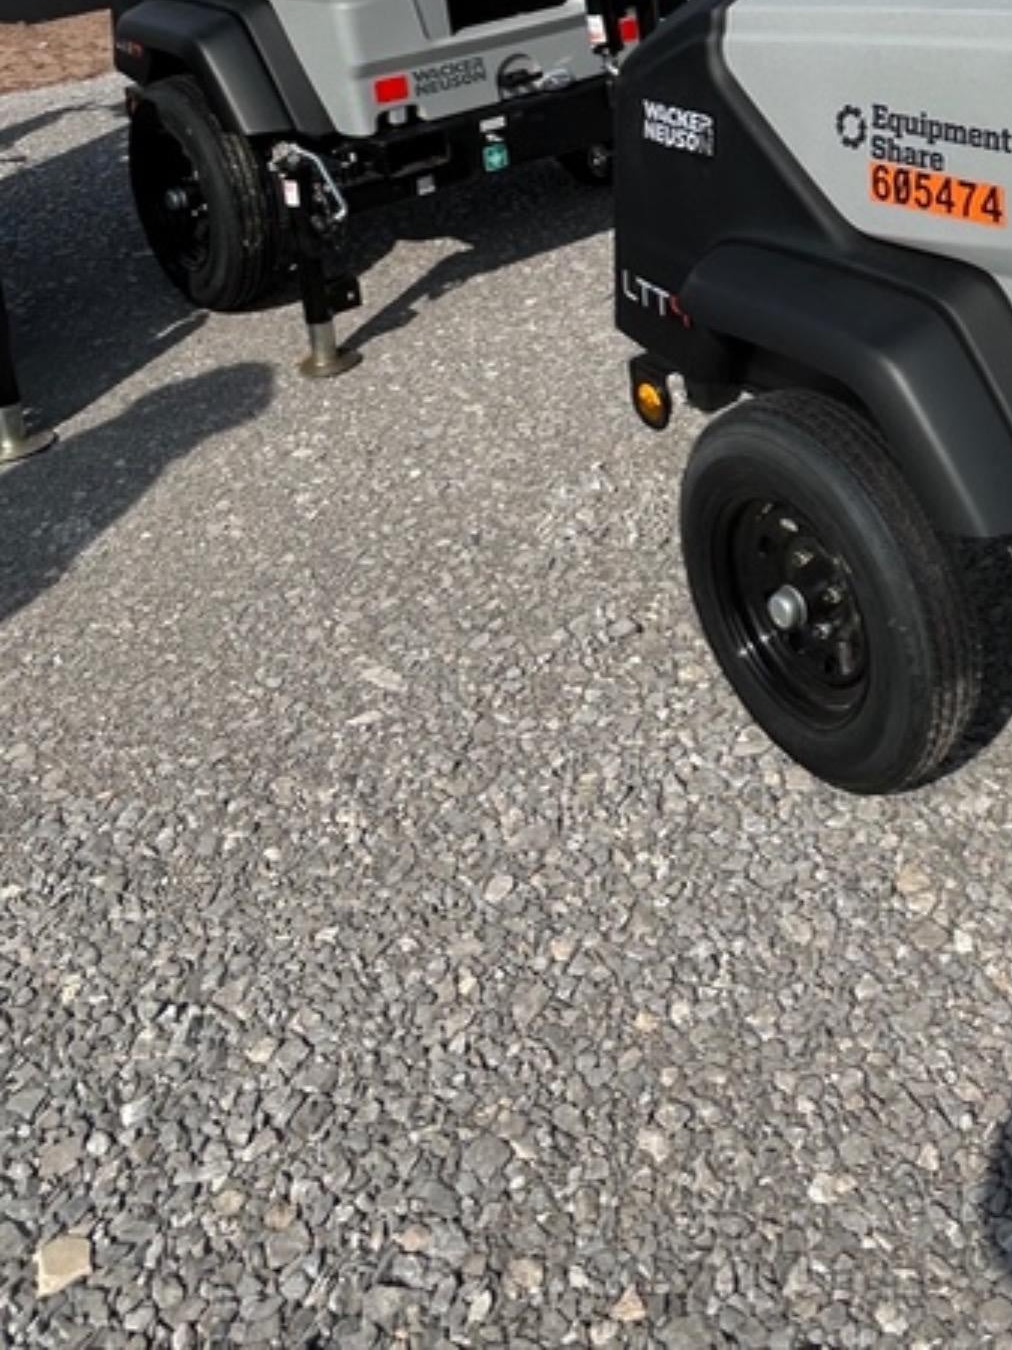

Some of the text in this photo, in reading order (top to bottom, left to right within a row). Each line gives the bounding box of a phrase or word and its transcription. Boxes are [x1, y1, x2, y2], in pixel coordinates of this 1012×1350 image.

[643, 99, 713, 132] WACKER
[872, 103, 1012, 153] Equipment
[643, 119, 714, 157] NEUSON
[871, 134, 944, 171] Share
[872, 163, 1003, 223] 605474
